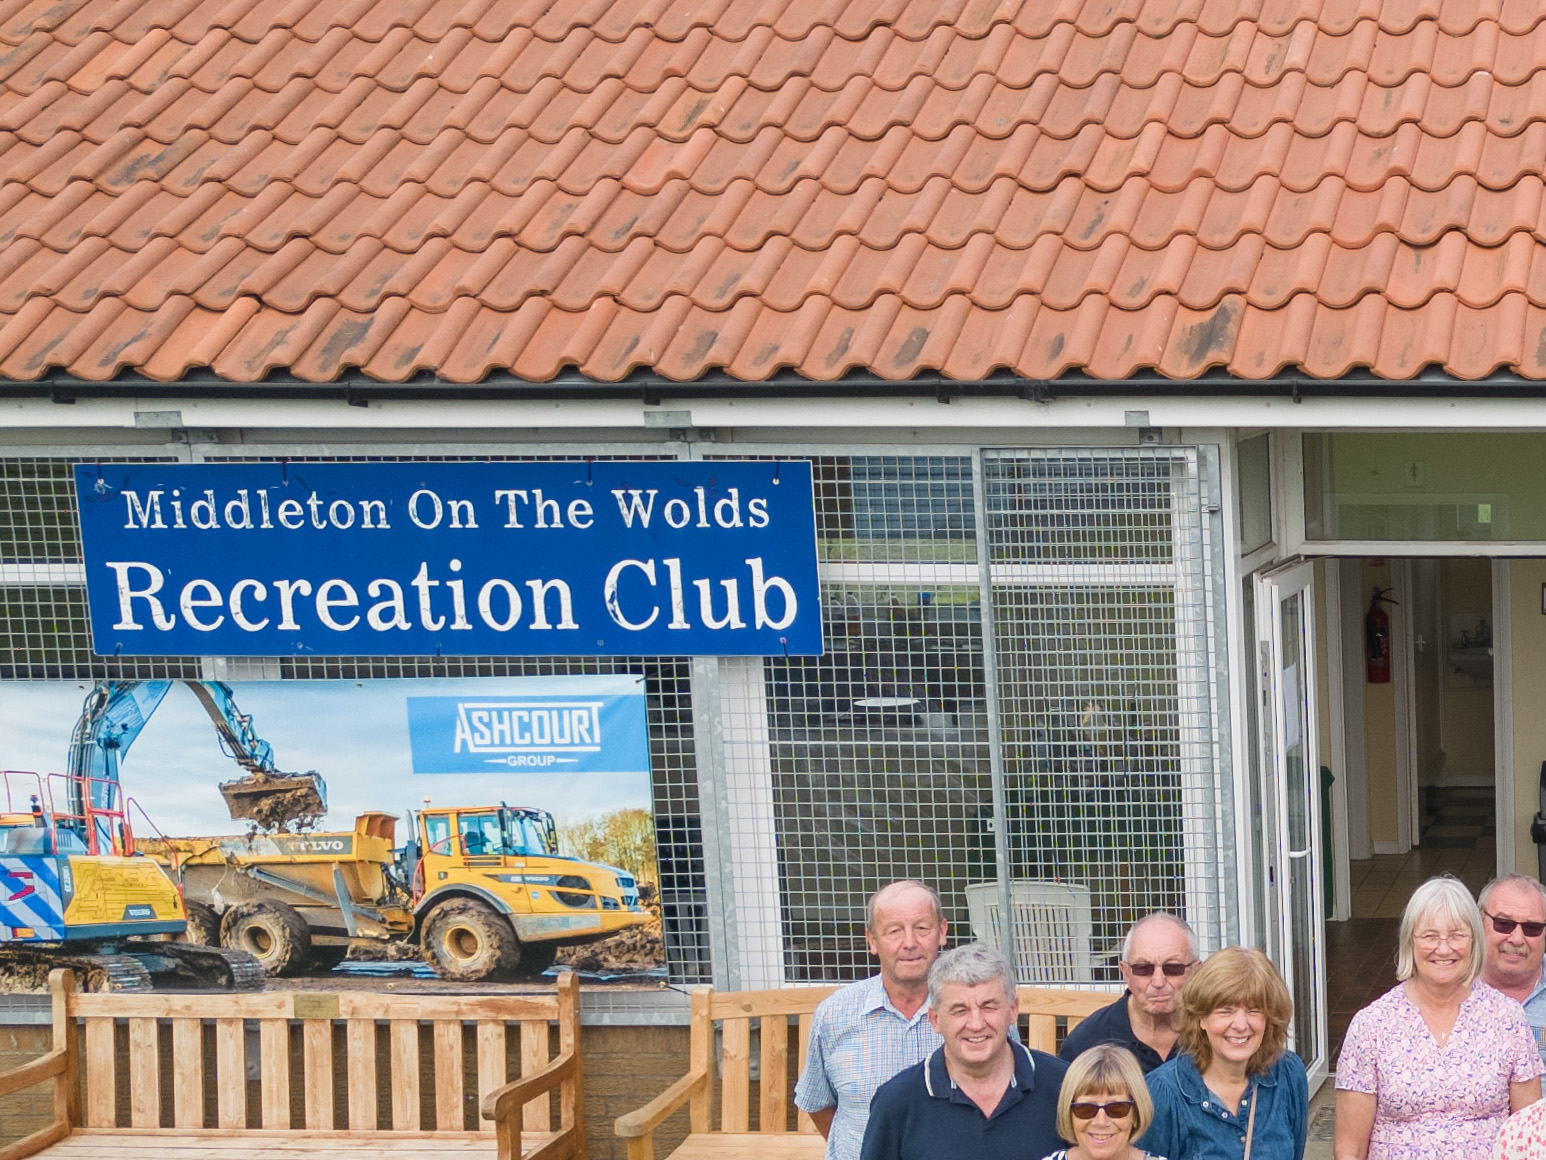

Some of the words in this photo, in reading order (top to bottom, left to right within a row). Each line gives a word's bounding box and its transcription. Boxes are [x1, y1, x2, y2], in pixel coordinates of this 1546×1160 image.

[120, 489, 392, 530] Middleton
[408, 489, 480, 530] On
[494, 488, 595, 530] The
[610, 486, 771, 529] Wolds
[105, 558, 580, 632] Recreation
[604, 556, 798, 632] Club
[454, 702, 604, 753] ASHCOURT
[506, 755, 556, 767] GROUP
